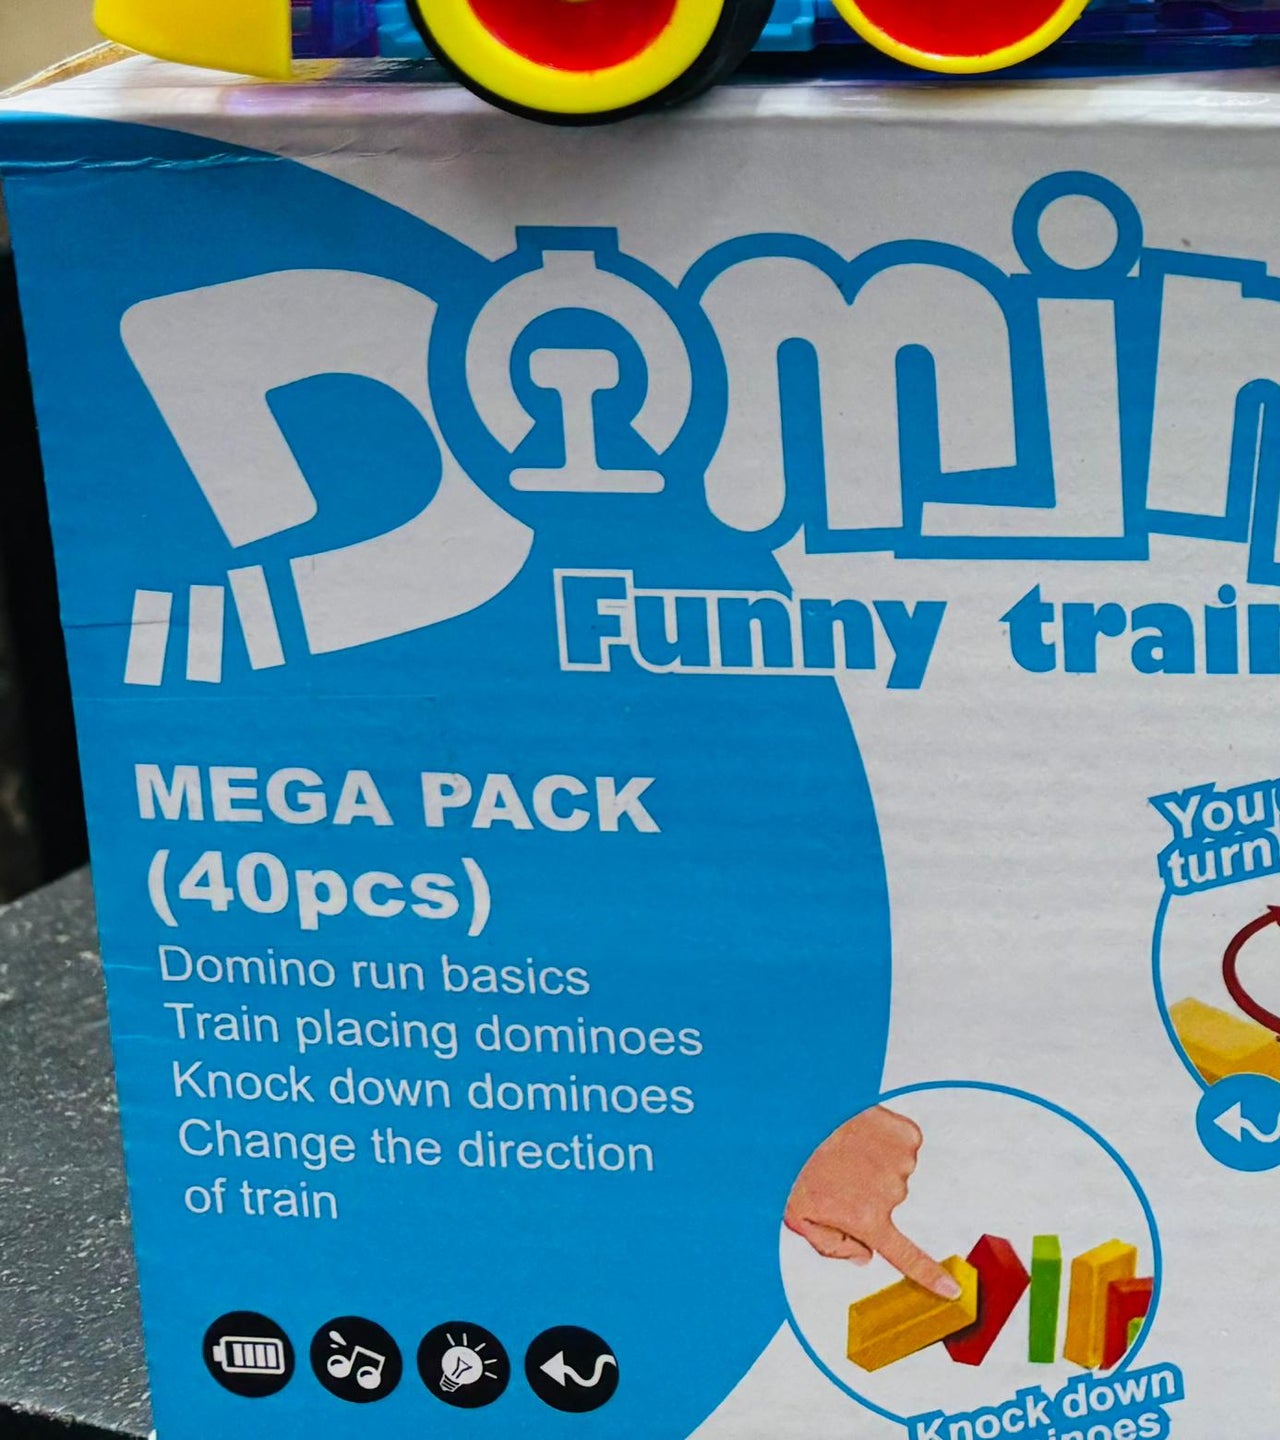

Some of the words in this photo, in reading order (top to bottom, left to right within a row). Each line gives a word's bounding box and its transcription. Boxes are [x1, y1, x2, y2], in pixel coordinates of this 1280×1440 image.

[554, 568, 947, 689] Funny
[135, 763, 394, 827] MEGA
[421, 772, 661, 834] PACK
[1164, 790, 1266, 839] You
[1167, 838, 1273, 888] turn
[148, 849, 491, 937] (40pcs)
[159, 945, 335, 987] Domino
[353, 961, 425, 990] run
[441, 954, 590, 996] basics
[164, 1002, 279, 1042] Train
[297, 1009, 458, 1059] placing
[475, 1014, 703, 1057] dominoes
[173, 1061, 314, 1103] Knock
[329, 1067, 450, 1108] down
[468, 1073, 695, 1115] dominoes
[179, 1118, 355, 1171] Change
[371, 1128, 441, 1166] the
[458, 1131, 654, 1172] direction
[185, 1177, 226, 1214] of
[240, 1180, 338, 1219] train
[917, 1395, 1051, 1440] Knock
[1062, 1370, 1175, 1418] down
